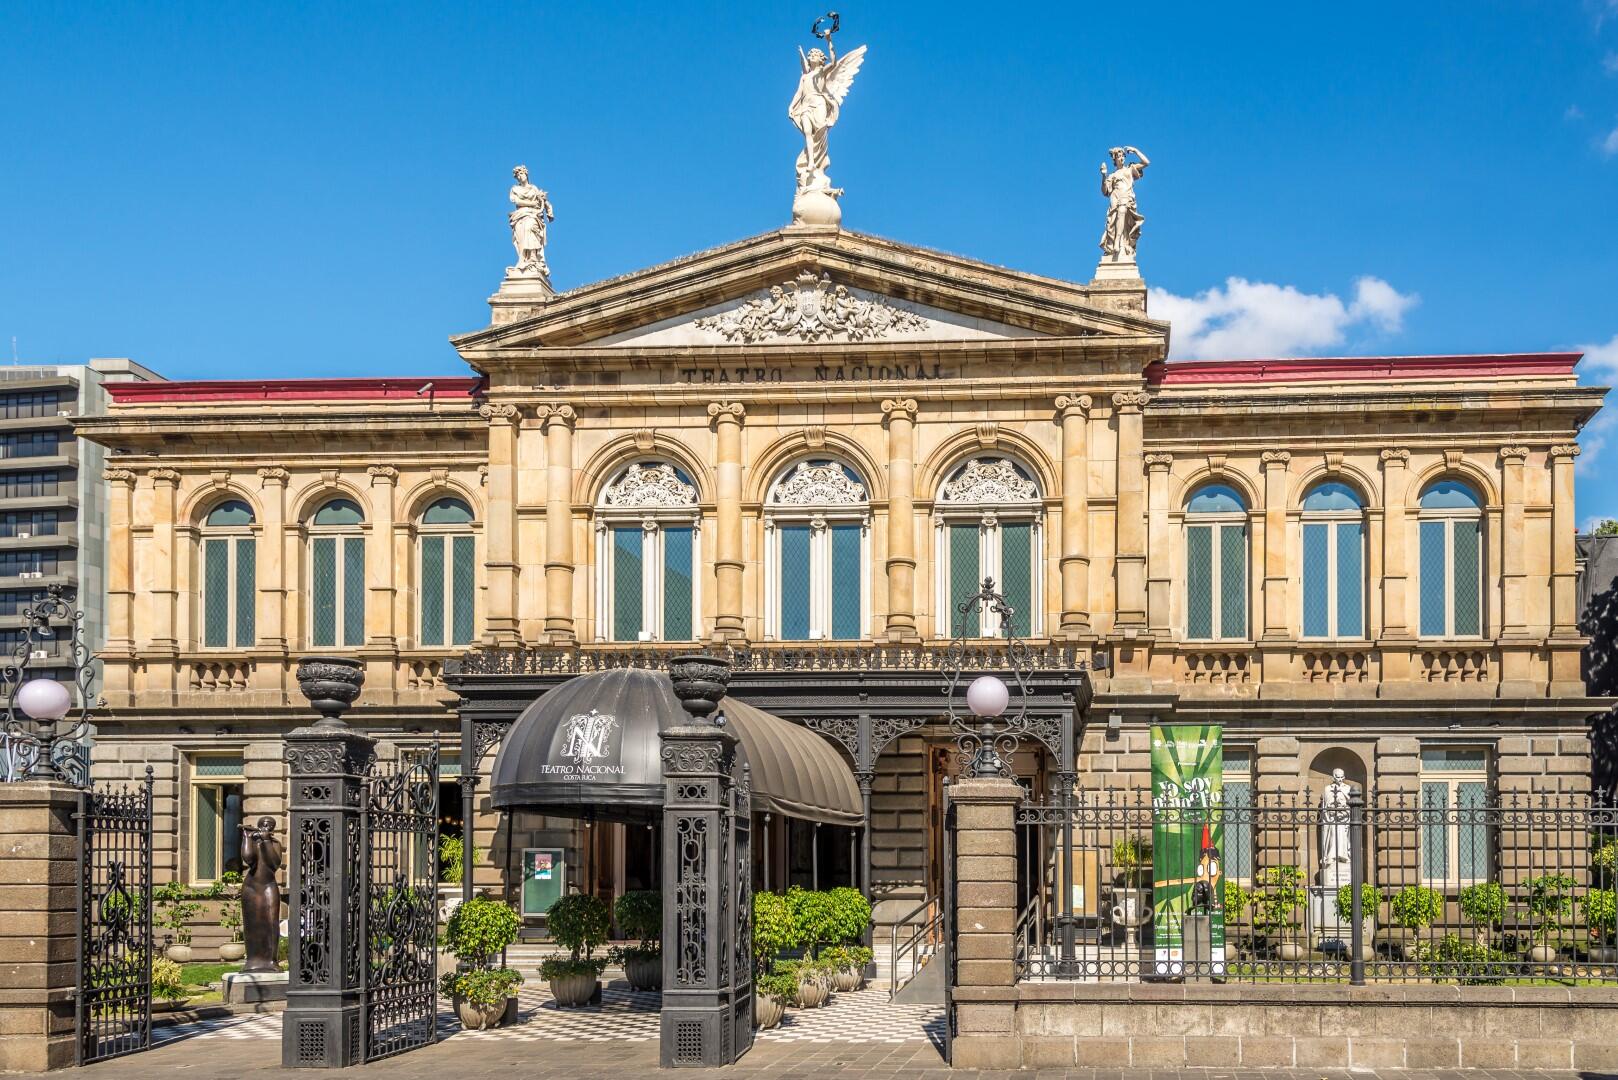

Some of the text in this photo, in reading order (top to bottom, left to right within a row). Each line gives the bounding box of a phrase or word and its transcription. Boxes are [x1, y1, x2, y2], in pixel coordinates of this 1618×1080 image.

[682, 364, 942, 383] TEATRO NACIONAL
[541, 765, 625, 774] TEATRO NACIONAL
